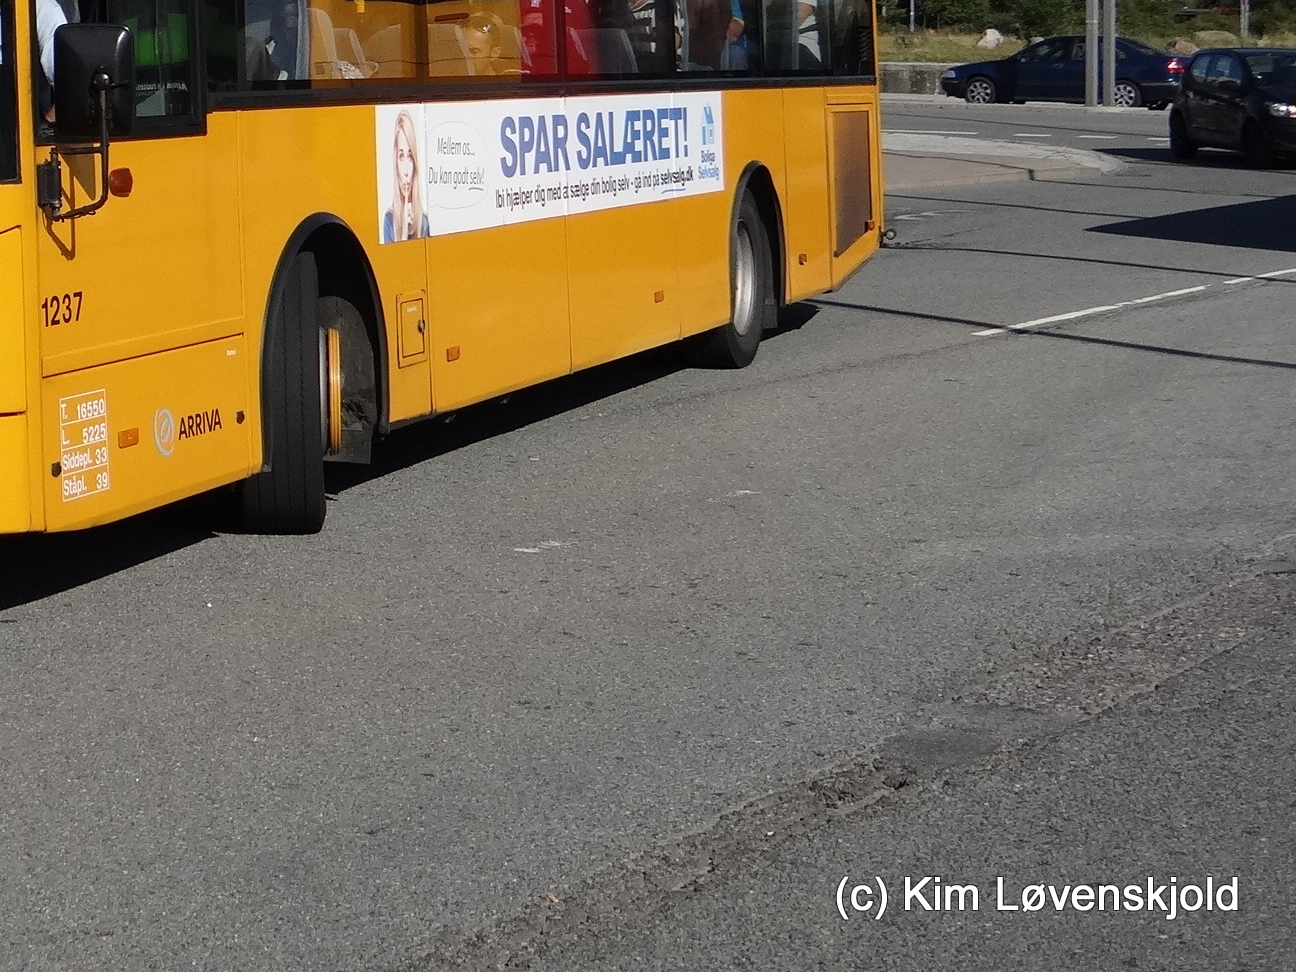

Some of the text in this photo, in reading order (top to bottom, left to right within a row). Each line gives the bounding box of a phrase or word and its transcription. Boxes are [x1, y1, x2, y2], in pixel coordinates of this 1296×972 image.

[436, 136, 462, 156] Mellem
[499, 106, 689, 179] SPAR SALÆRET!
[428, 165, 485, 190] Du kan godt selv!
[698, 163, 720, 181] Selvsalg
[505, 186, 533, 212] hjælper
[533, 184, 546, 207] dig
[546, 181, 562, 202] med
[569, 179, 590, 202] sælge
[590, 177, 601, 196] din
[601, 175, 617, 197] bolig
[617, 173, 630, 192] selv
[642, 170, 652, 188] ind
[652, 168, 660, 191] på
[660, 165, 694, 187] selvsalg.dk
[41, 291, 83, 328] 1237
[60, 398, 105, 421] T. 16550
[62, 422, 106, 445] L. 5225
[178, 408, 223, 441] ARRIVA
[62, 446, 107, 470] Siddepl. 33
[63, 471, 108, 496] Ståpl. 39
